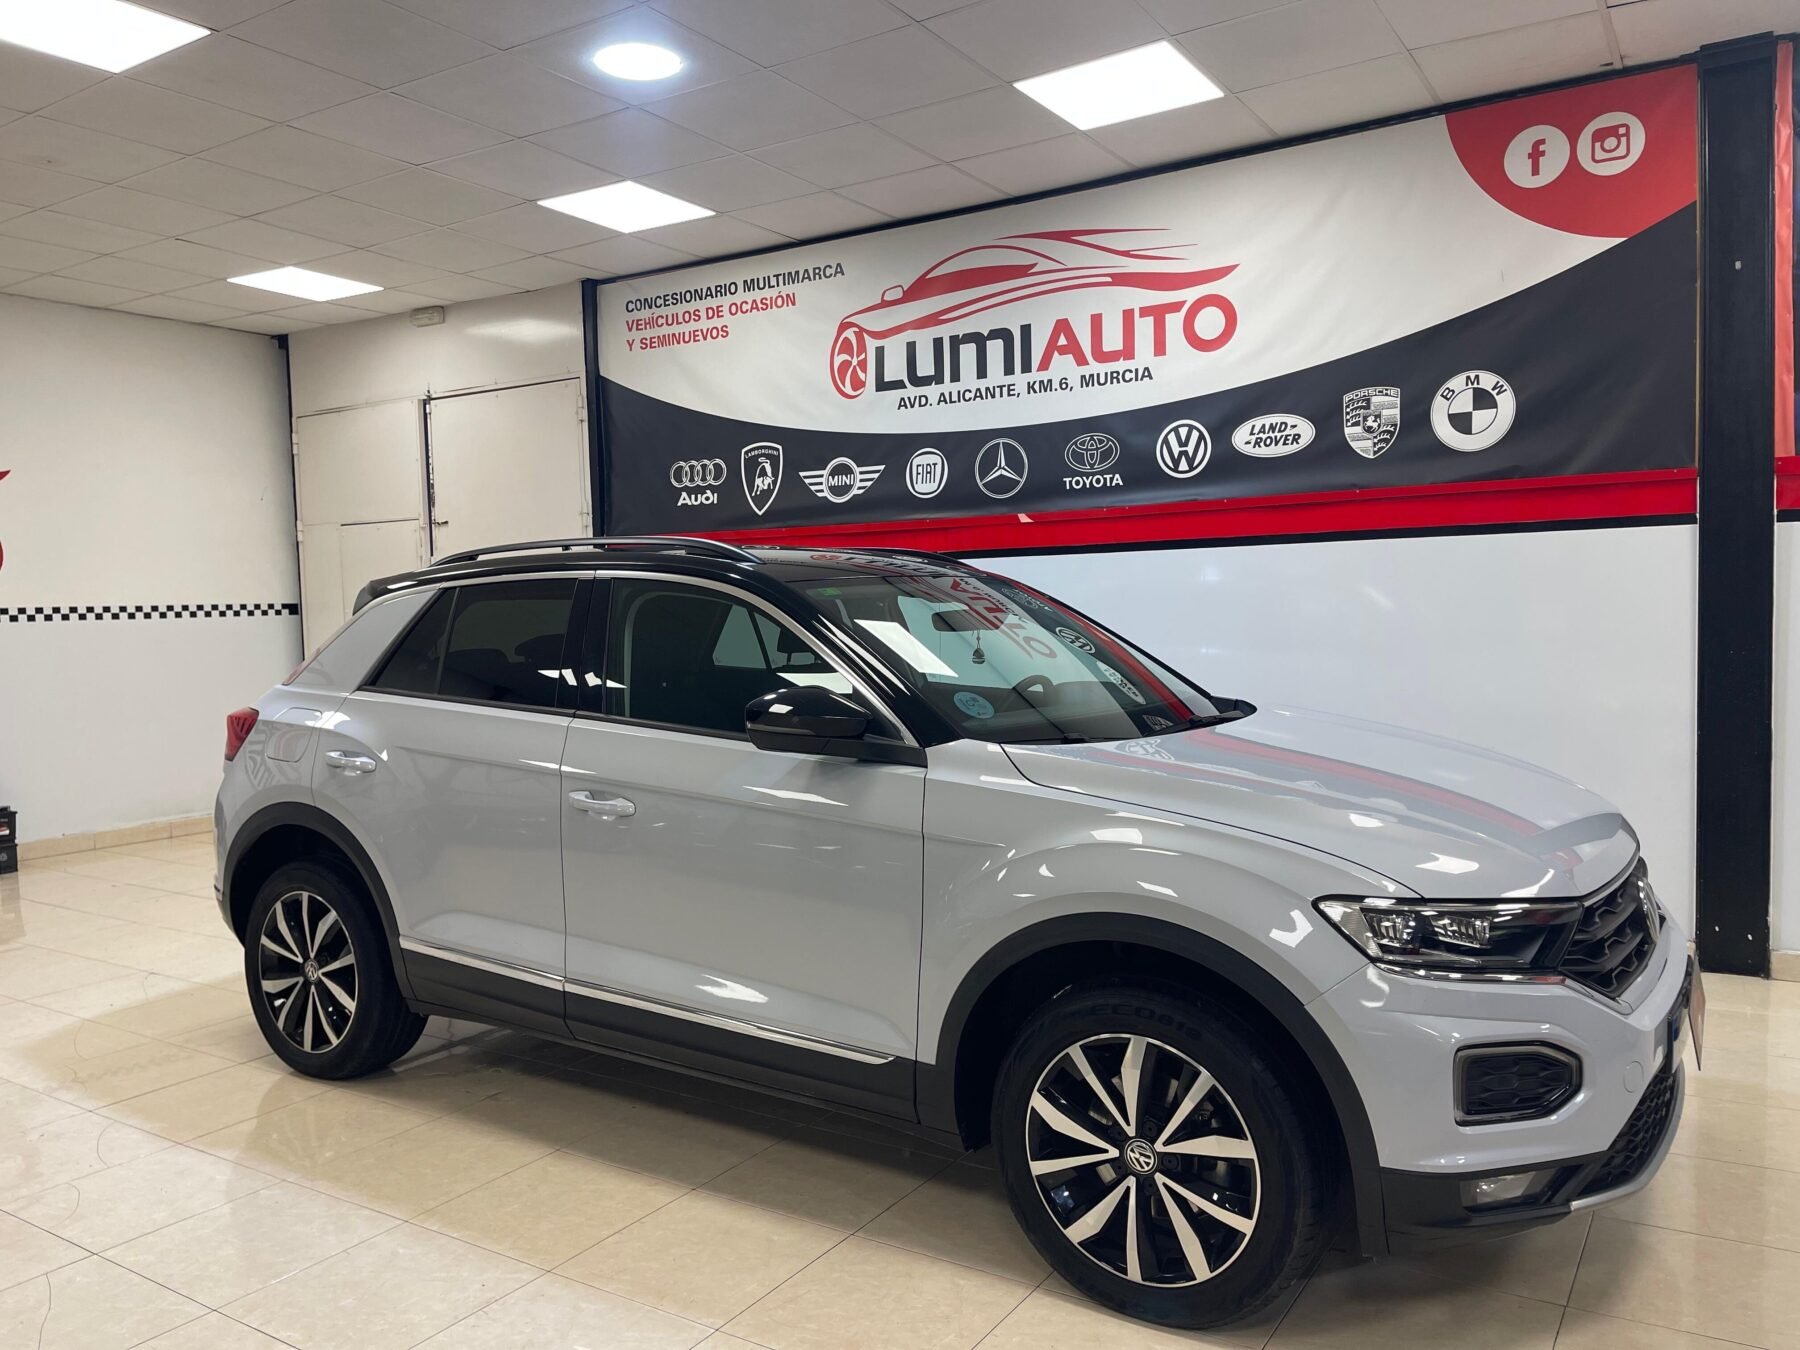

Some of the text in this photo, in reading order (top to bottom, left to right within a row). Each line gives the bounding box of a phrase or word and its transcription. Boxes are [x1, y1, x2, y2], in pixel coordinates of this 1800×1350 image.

[626, 262, 845, 313] CONCESIONARIO MULTIMARCA
[626, 291, 796, 332] VEHÍCULOS DE OCASIÓN
[627, 325, 729, 351] Y SEMINUEVOS
[897, 366, 1153, 410] AVD. ALICANTE, KM.6, MURCIA
[1345, 388, 1398, 403] PORSCHE
[745, 448, 779, 459] LAMBORGHINI
[828, 474, 854, 487] MINI
[915, 462, 938, 485] FIAT
[1063, 473, 1123, 490] TOYOTA
[677, 490, 718, 506] Audi
